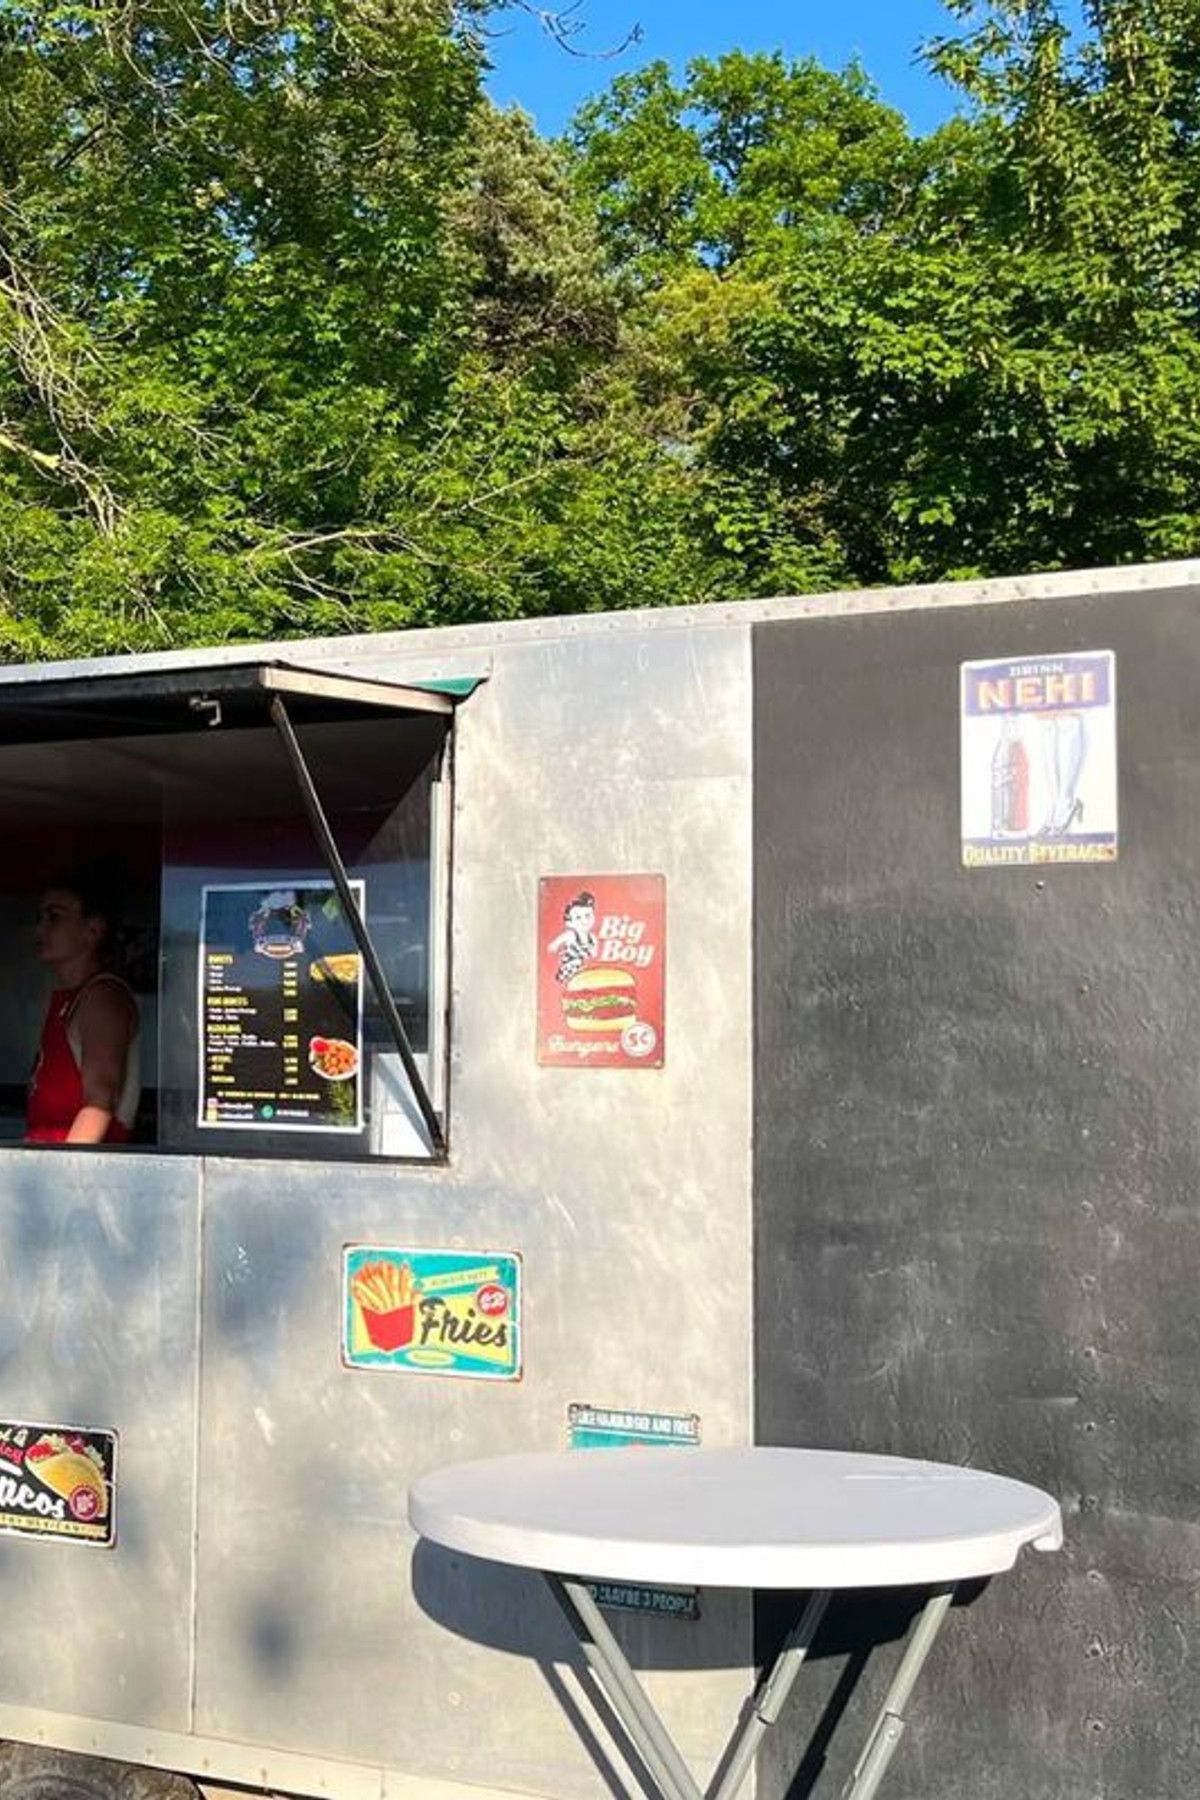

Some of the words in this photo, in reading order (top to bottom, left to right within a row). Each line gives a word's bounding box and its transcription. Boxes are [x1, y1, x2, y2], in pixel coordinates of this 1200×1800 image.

[977, 672, 1097, 711] NEHI
[964, 846, 1026, 865] QUALITY
[600, 915, 648, 944] Big
[601, 938, 655, 967] Boy
[419, 1296, 508, 1348] Fries
[652, 1417, 672, 1434] AND
